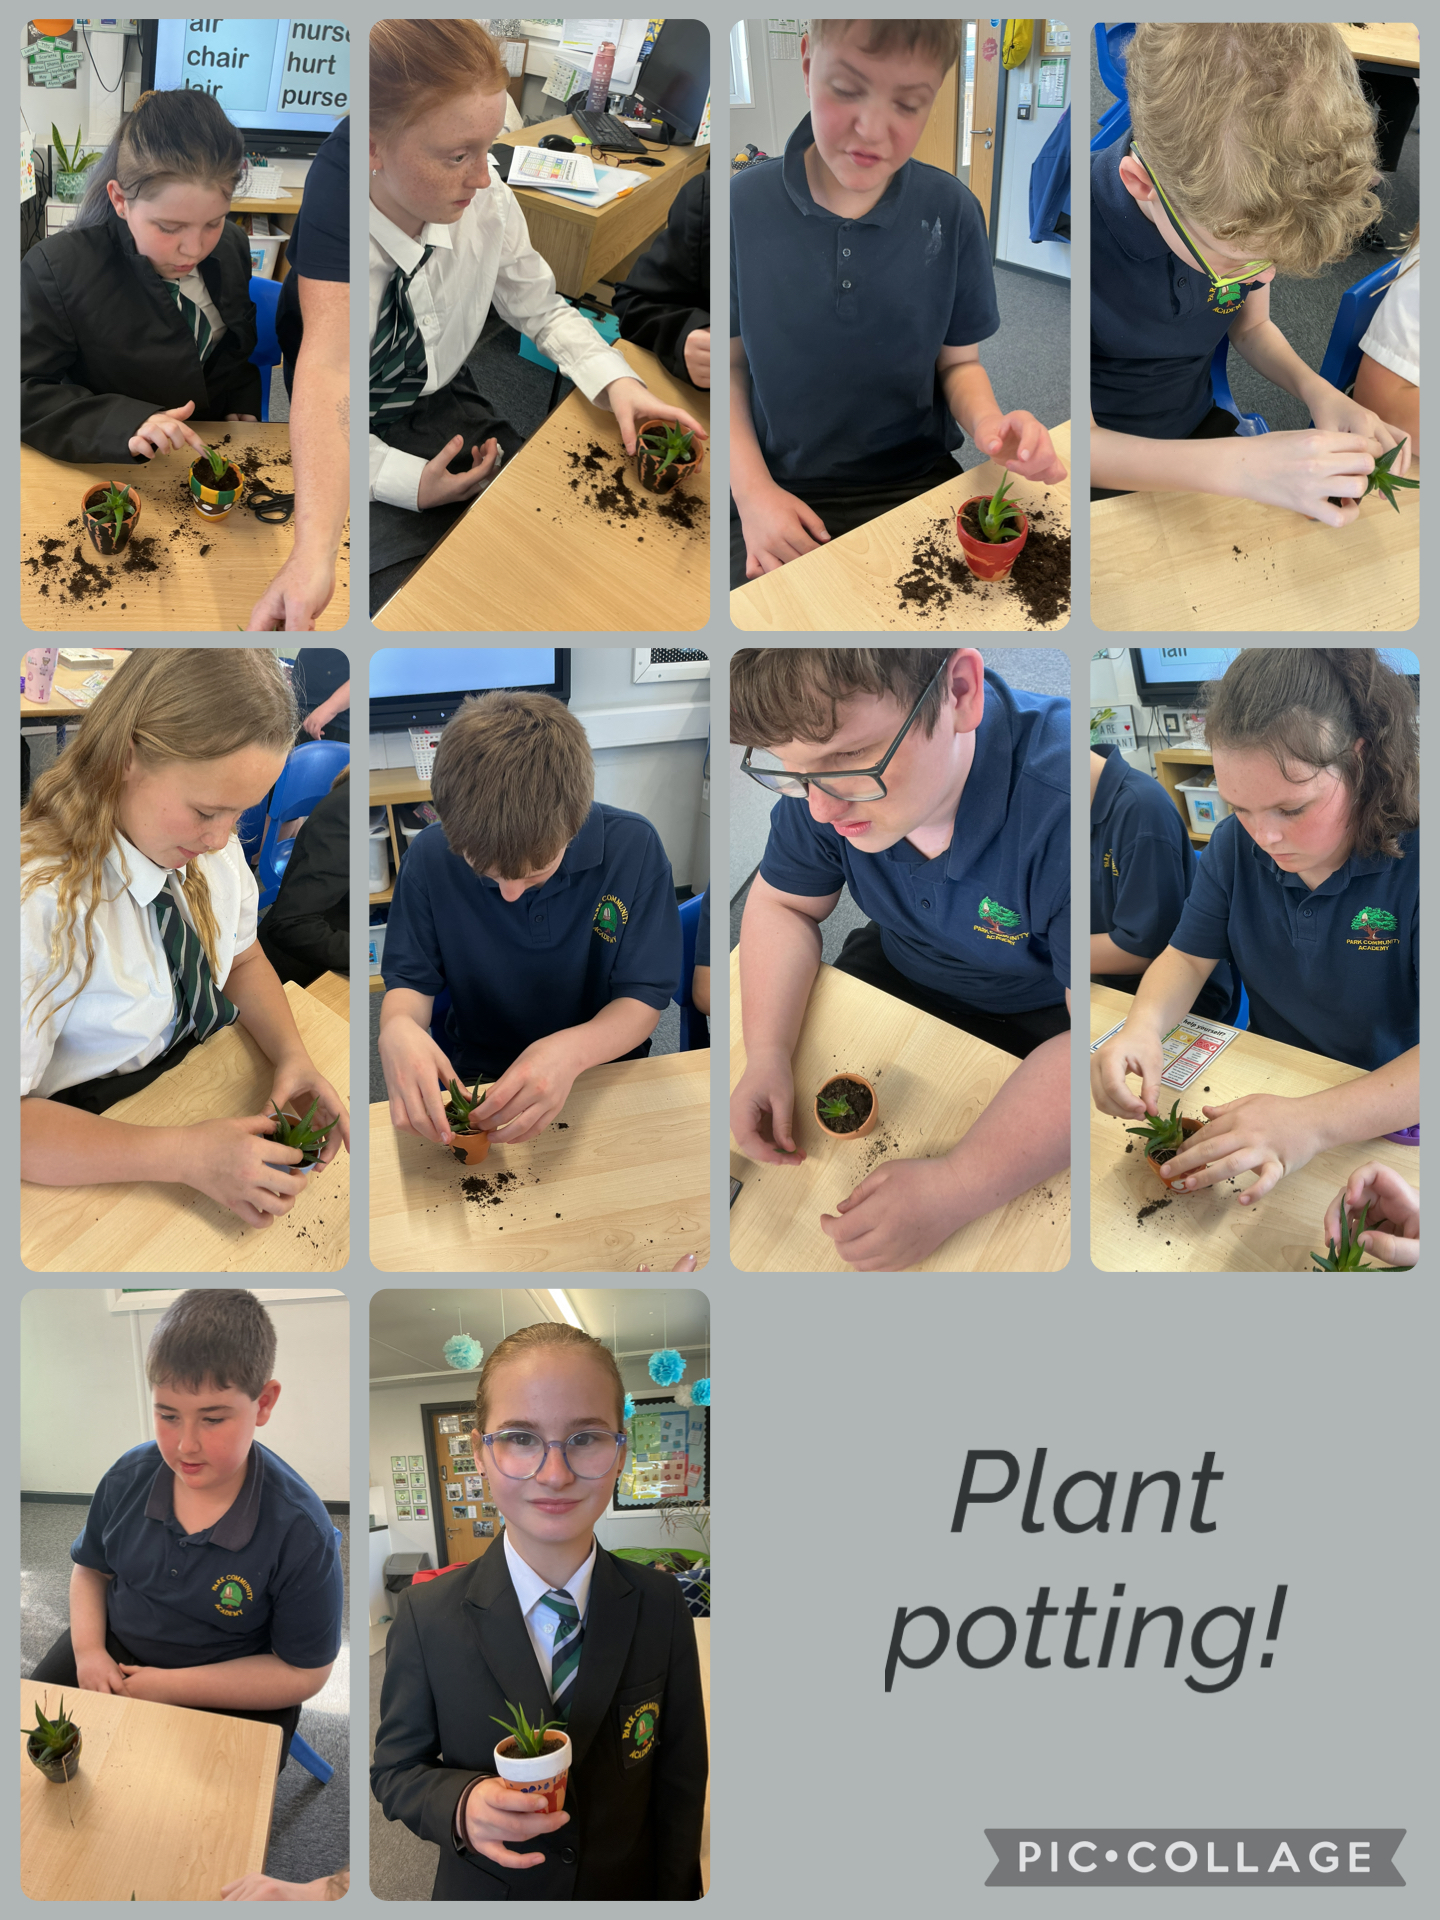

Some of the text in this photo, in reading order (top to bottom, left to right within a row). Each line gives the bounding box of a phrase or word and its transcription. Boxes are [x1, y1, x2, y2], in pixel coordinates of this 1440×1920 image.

[292, 22, 351, 43] nurs
[187, 45, 250, 69] chair
[287, 51, 337, 75] hurt
[281, 88, 348, 109] purse
[601, 894, 629, 925] COMMUNITY
[592, 926, 617, 944] ACADEMY
[1182, 1018, 1197, 1028] help
[1196, 1024, 1226, 1036] yourself?
[211, 1574, 253, 1602] PARK COMMUNITY
[214, 1603, 244, 1617] ACADEMY
[622, 1715, 636, 1740] PARK
